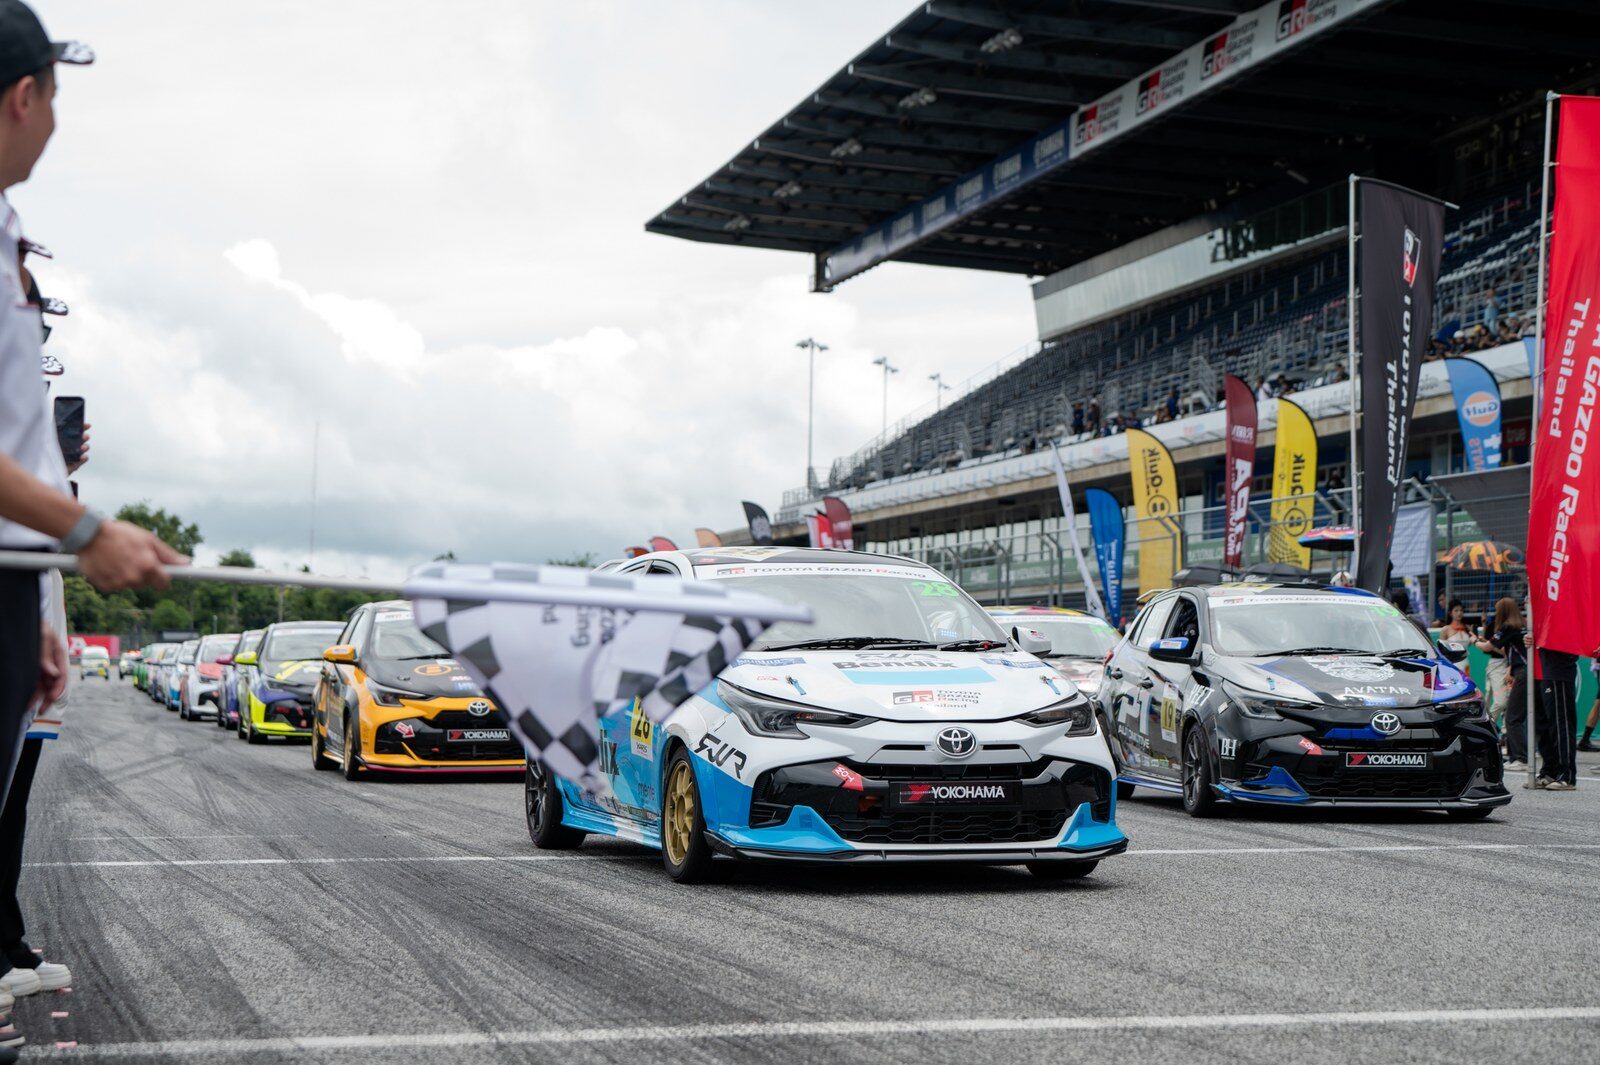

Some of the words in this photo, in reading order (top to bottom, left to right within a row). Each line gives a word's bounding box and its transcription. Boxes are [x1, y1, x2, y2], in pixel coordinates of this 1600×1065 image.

[1549, 298, 1591, 438] Thailand
[1387, 360, 1398, 486] Thailand
[1547, 484, 1580, 602] Racing
[875, 568, 926, 578] Racing
[911, 581, 959, 597] 28
[832, 661, 957, 669] Bendix
[1344, 685, 1411, 695] AVATAR
[892, 690, 934, 705] GR
[1164, 701, 1174, 728] 19
[463, 730, 508, 740] YOKOHAMA
[1367, 754, 1423, 765] YOKOHAMA
[931, 786, 1005, 798] YOKOHAMA
